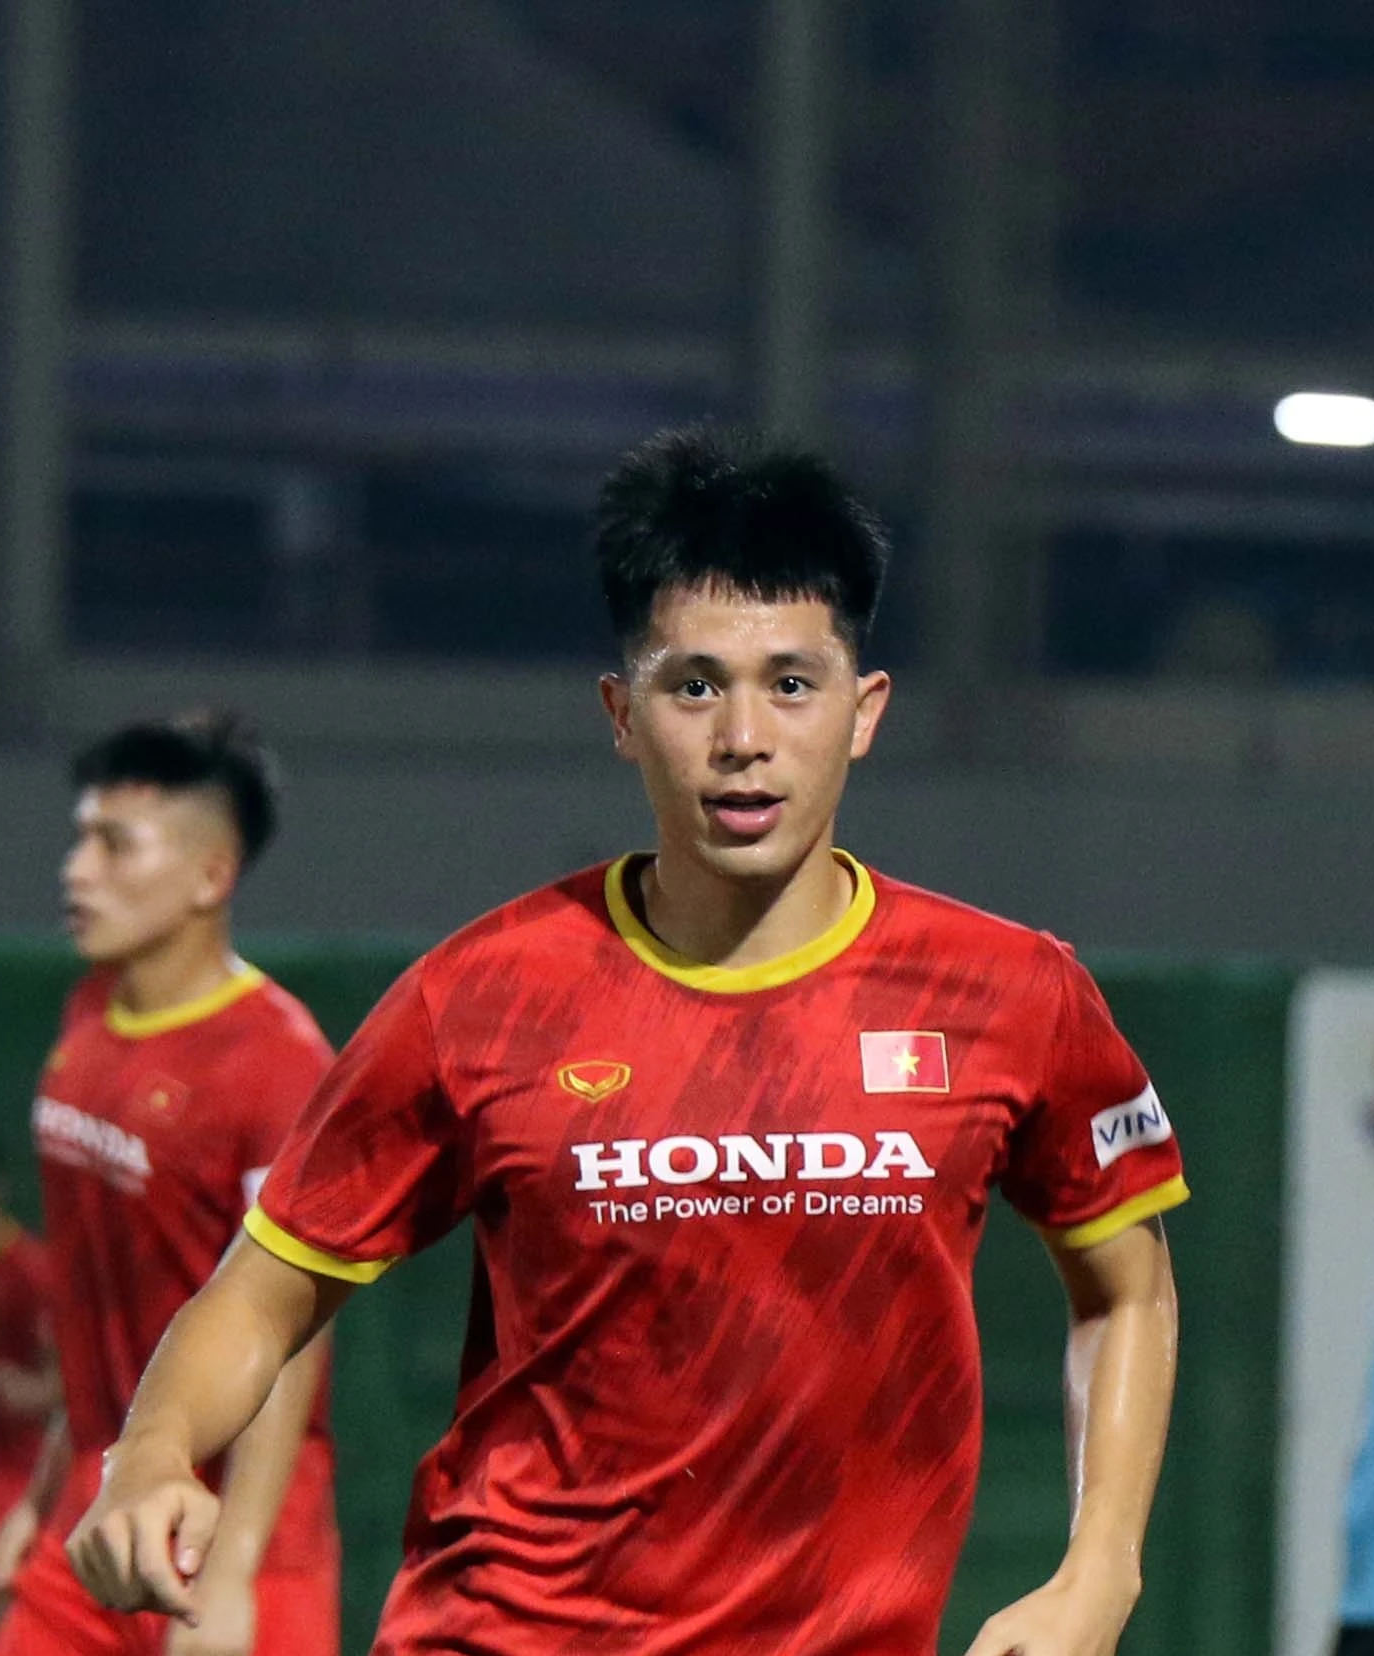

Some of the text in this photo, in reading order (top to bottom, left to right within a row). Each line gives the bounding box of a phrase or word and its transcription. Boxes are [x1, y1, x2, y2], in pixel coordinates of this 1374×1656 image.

[571, 1131, 936, 1191] HONDA
[589, 1191, 923, 1225] The Power of Dreams
